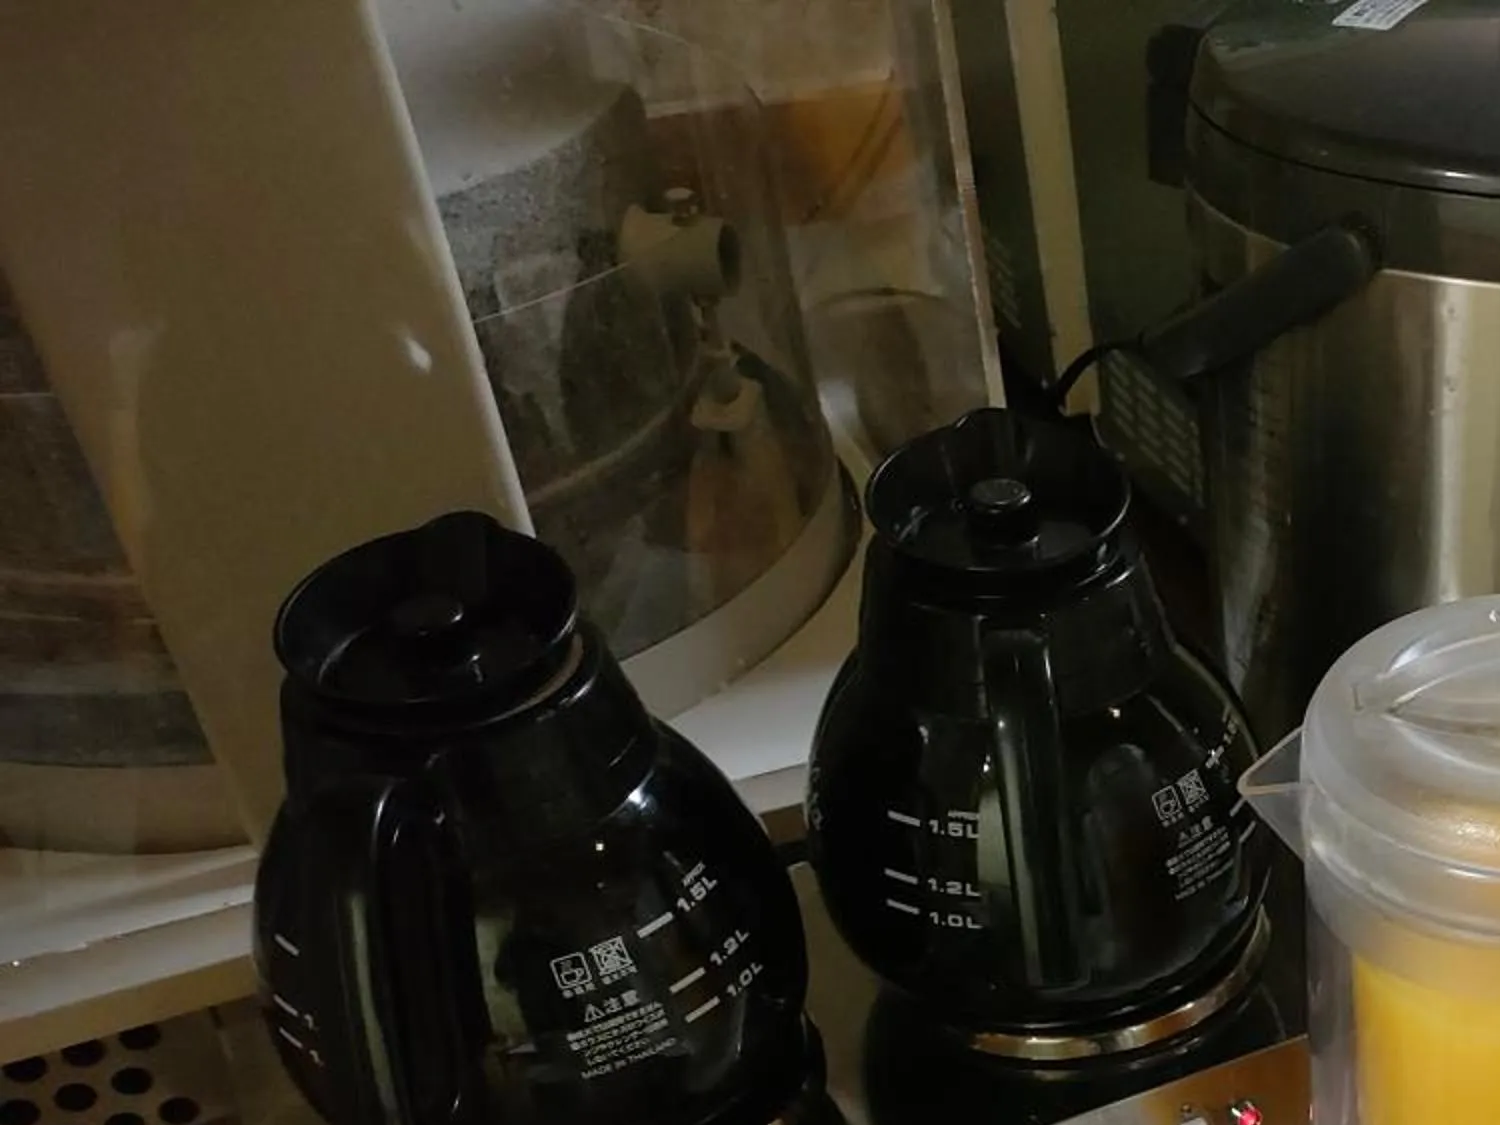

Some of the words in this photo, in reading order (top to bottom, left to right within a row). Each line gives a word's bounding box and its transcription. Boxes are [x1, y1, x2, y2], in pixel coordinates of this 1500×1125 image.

[929, 819, 980, 839] 1.5L
[677, 875, 718, 912] 1.5L
[928, 877, 981, 897] 1.2L
[929, 911, 983, 930] 1.0L
[709, 929, 750, 966] 1.2L
[728, 961, 763, 997] 1.0L
